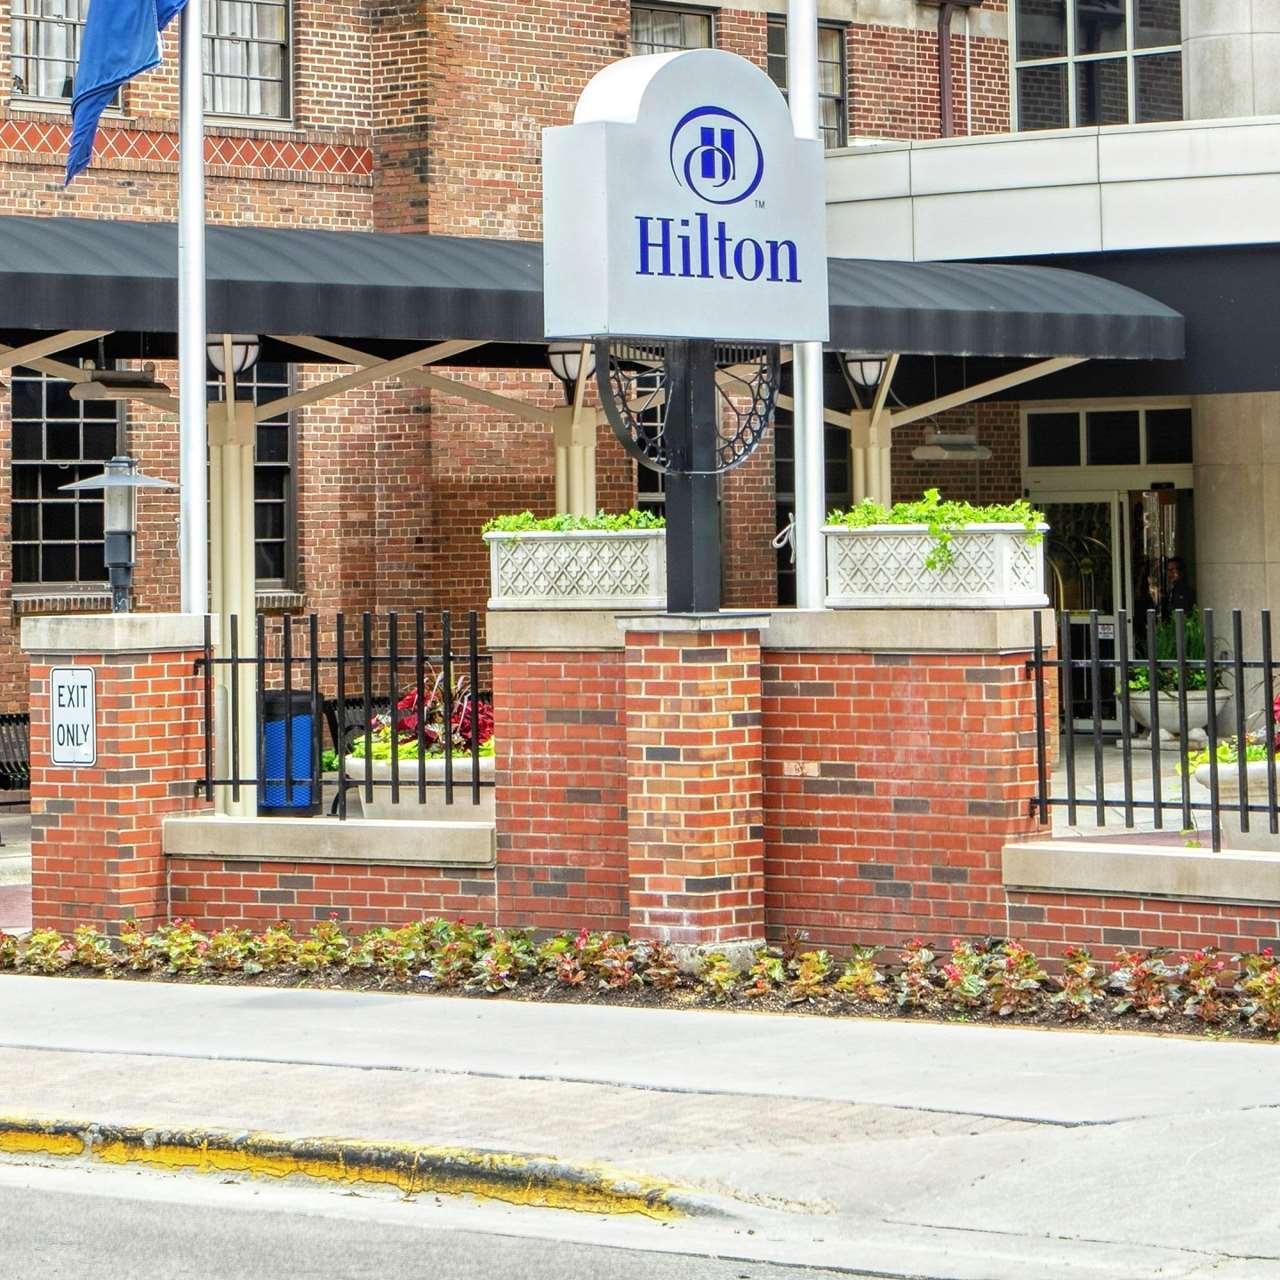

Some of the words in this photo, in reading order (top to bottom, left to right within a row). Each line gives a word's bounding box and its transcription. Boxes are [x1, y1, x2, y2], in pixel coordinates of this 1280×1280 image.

[634, 212, 802, 283] Hilton
[57, 685, 88, 708] EXIT
[56, 723, 90, 747] ONLY
